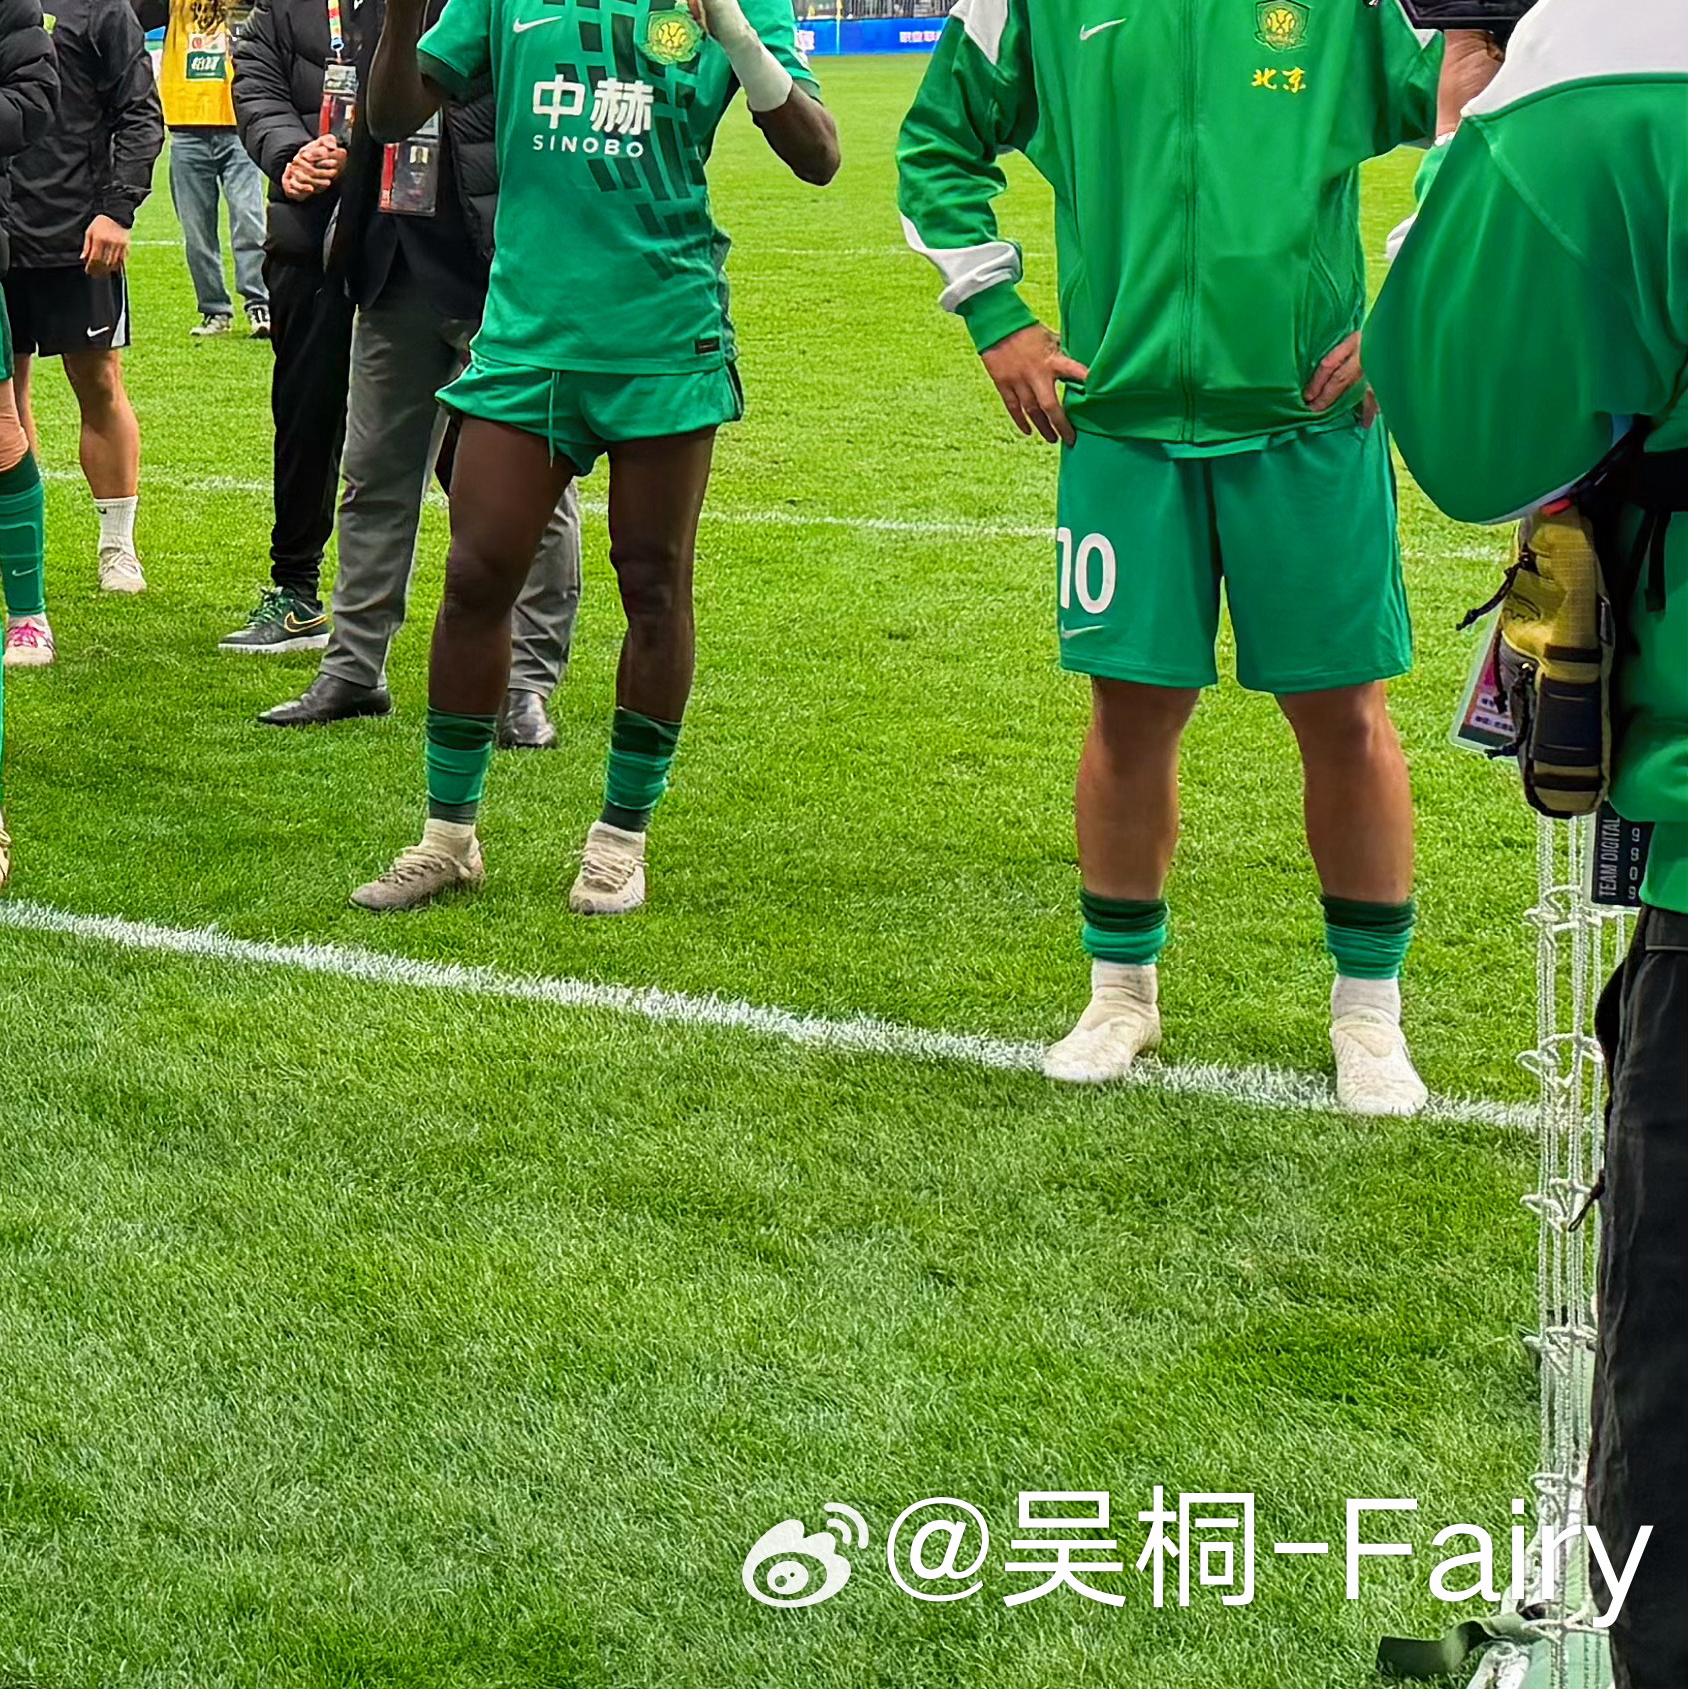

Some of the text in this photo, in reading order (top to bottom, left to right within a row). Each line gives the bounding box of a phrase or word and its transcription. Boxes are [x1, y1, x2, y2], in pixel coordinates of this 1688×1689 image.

[1251, 67, 1307, 93] 北京
[533, 74, 655, 136] 中赫
[533, 133, 644, 159] SINOBO
[1057, 525, 1117, 615] 10
